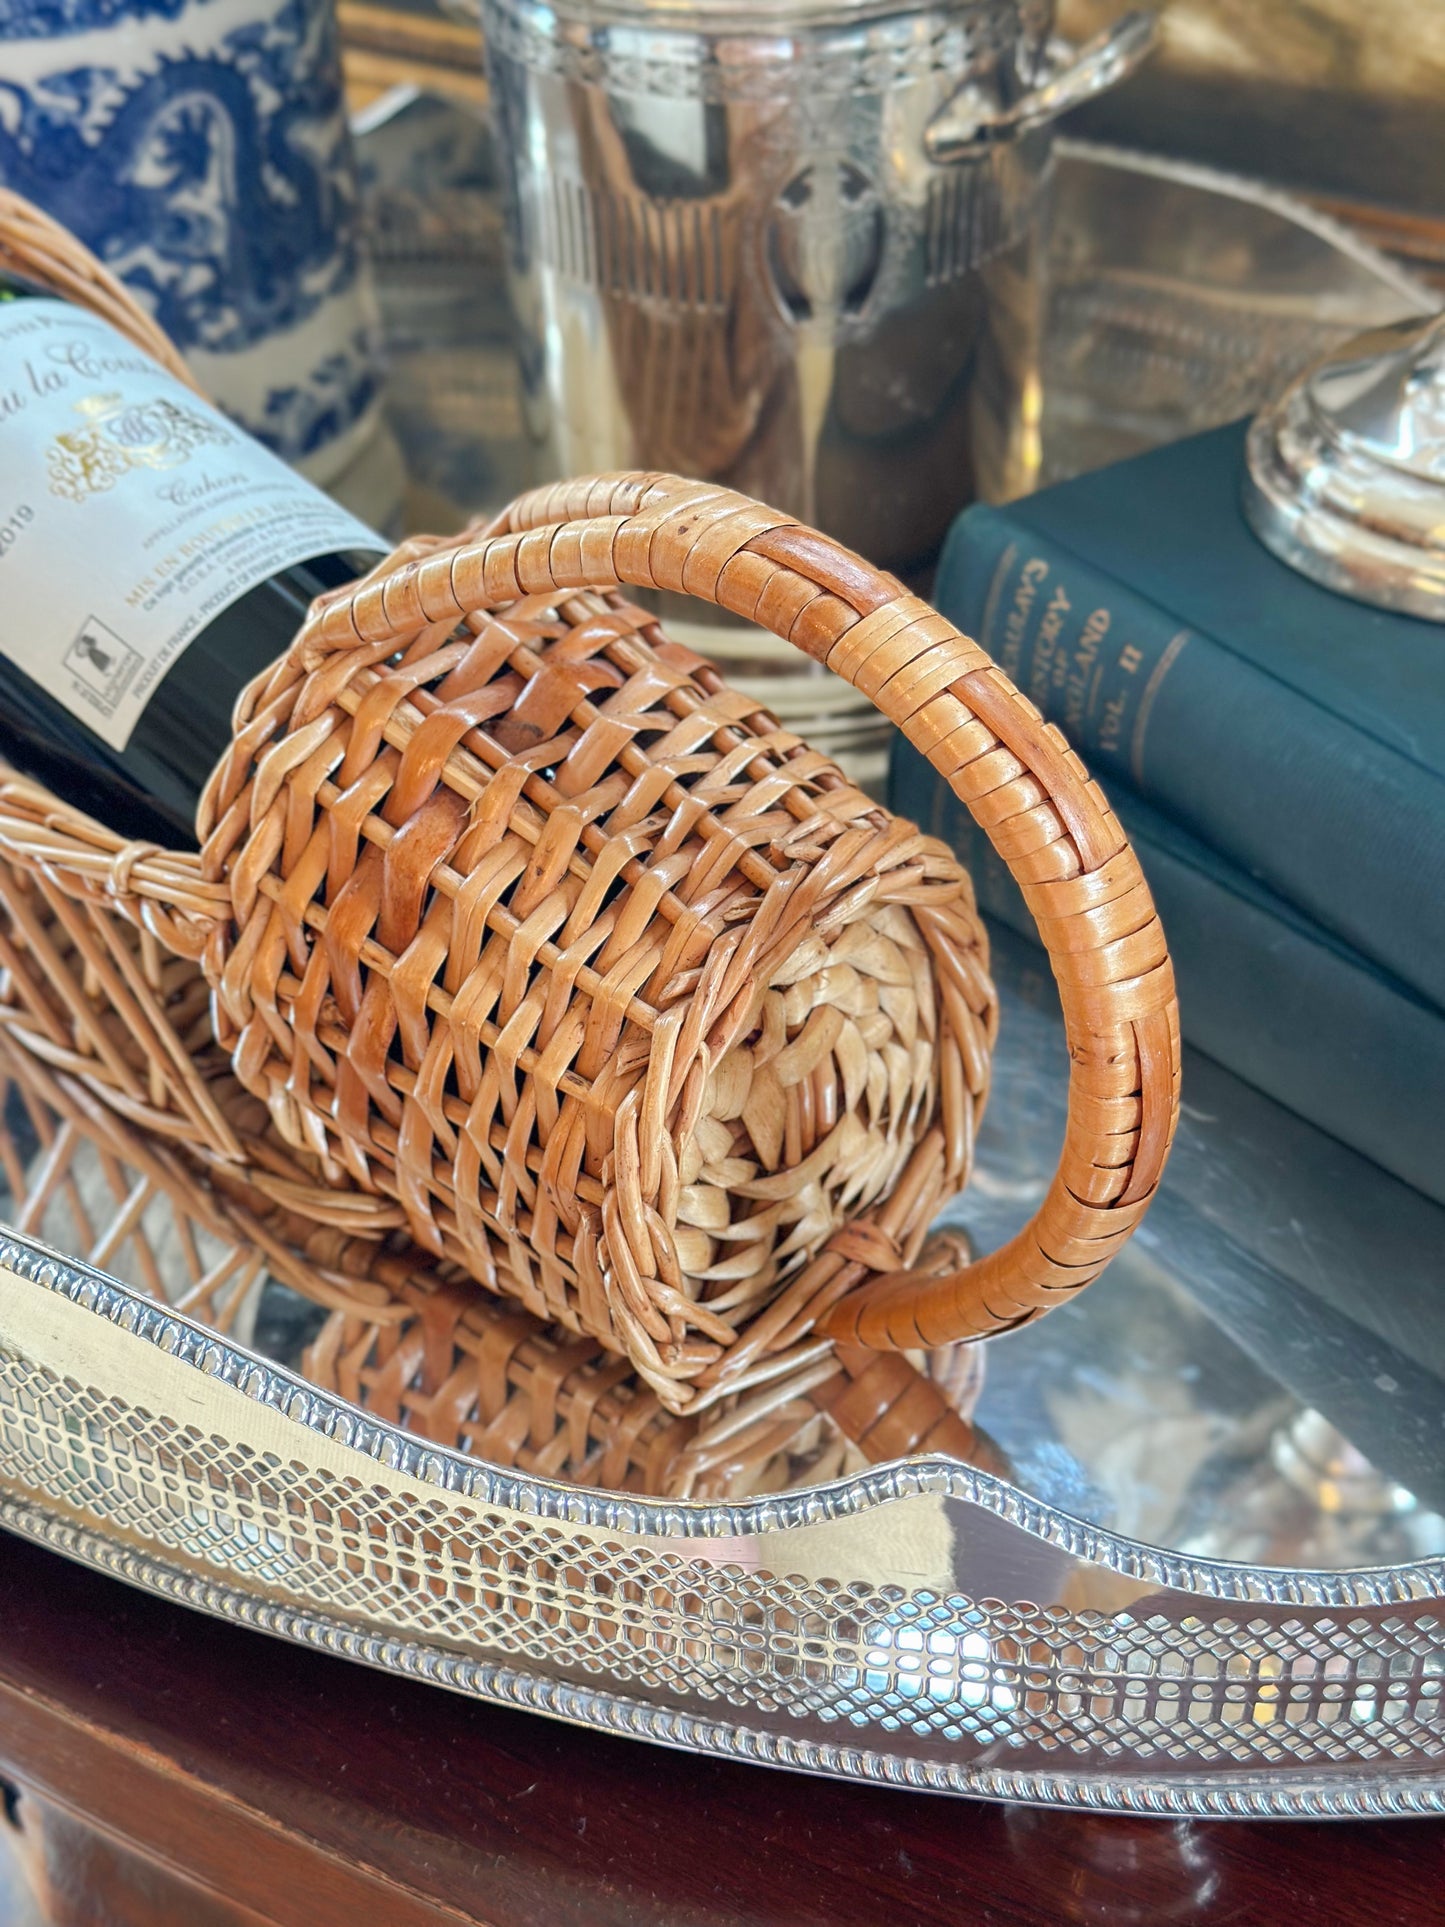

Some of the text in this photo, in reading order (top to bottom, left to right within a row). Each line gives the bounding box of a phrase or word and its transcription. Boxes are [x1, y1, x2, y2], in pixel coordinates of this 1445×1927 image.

[24, 360, 69, 397] la
[124, 576, 157, 608] MIS
[154, 554, 180, 578] EN
[167, 614, 199, 650] FRANCE
[200, 579, 239, 617] PRODUCT
[1030, 585, 1072, 712] ISTORY
